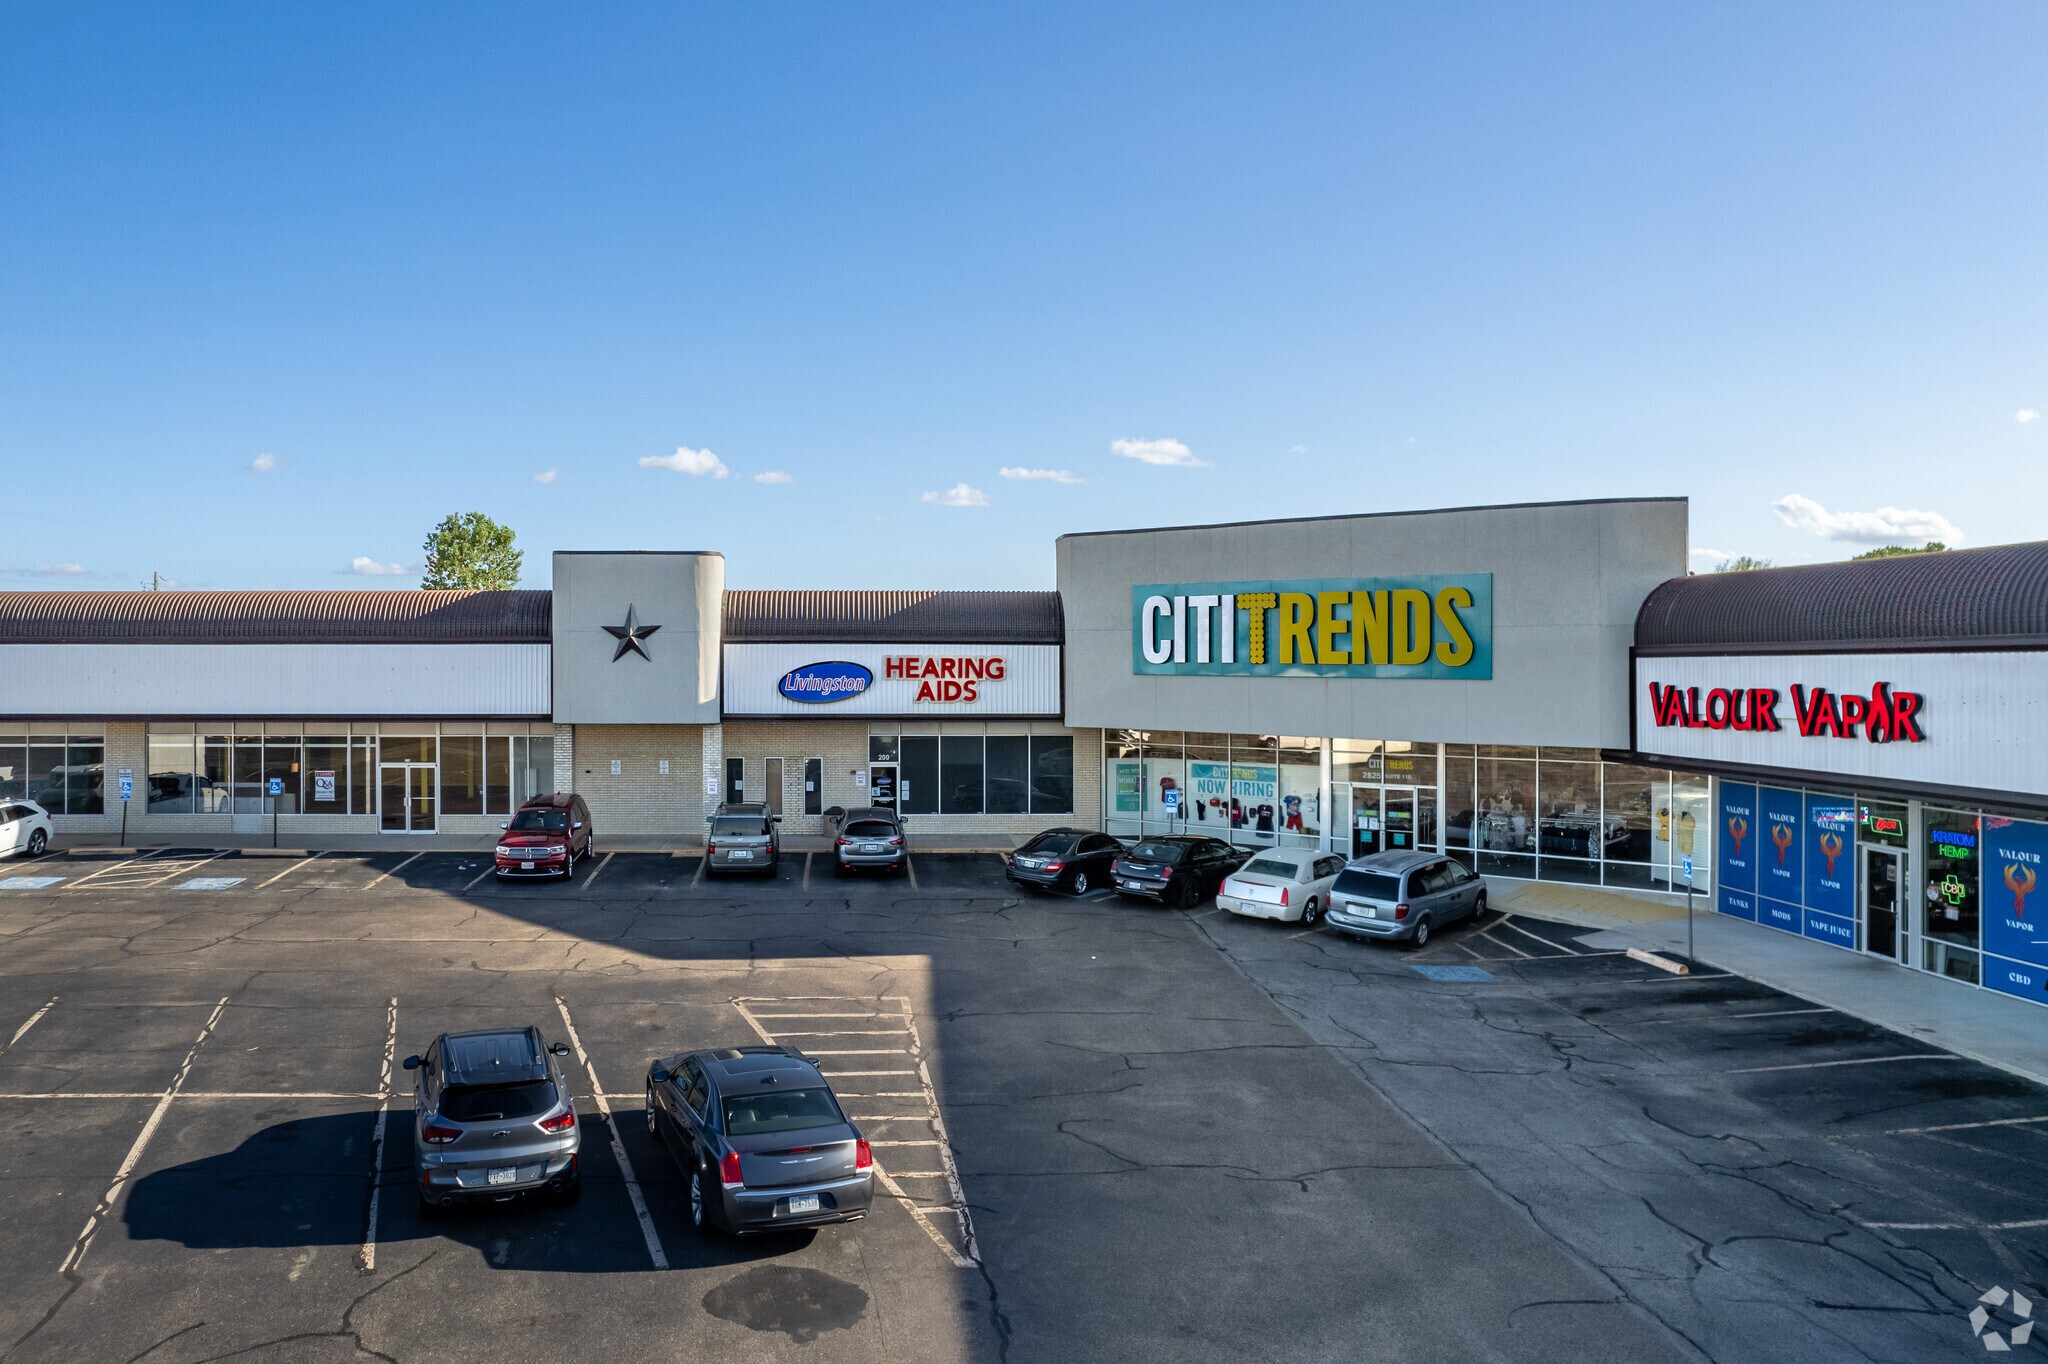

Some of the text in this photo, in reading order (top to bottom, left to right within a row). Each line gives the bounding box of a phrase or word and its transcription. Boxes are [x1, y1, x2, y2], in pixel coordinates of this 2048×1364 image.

[884, 656, 1005, 680] HEARING
[784, 673, 866, 695] Livingston
[915, 680, 978, 702] AIDS
[1649, 681, 1781, 732] VALOUR
[1362, 771, 1381, 779] 2825
[316, 778, 333, 790] Q&A
[1197, 779, 1274, 798] NOW HIRING
[1726, 805, 1750, 816] VALOUR
[1769, 812, 1796, 824] VALOUR
[1816, 820, 1846, 833] VALOUR
[1932, 830, 1975, 847] KRATOM
[1939, 844, 1969, 859] HEMP
[1999, 848, 2041, 864] VALOUR
[1729, 858, 1746, 868] VAPOR
[1772, 868, 1791, 878] VAPOR
[1820, 879, 1841, 890] VAPOR
[1944, 883, 1964, 895] CBD
[1728, 897, 1749, 909] TANKS
[1771, 909, 1792, 921] MODS
[1810, 920, 1852, 938] VAPE JUICE
[2005, 919, 2034, 932] VAPOR
[2008, 972, 2031, 986] CBD
